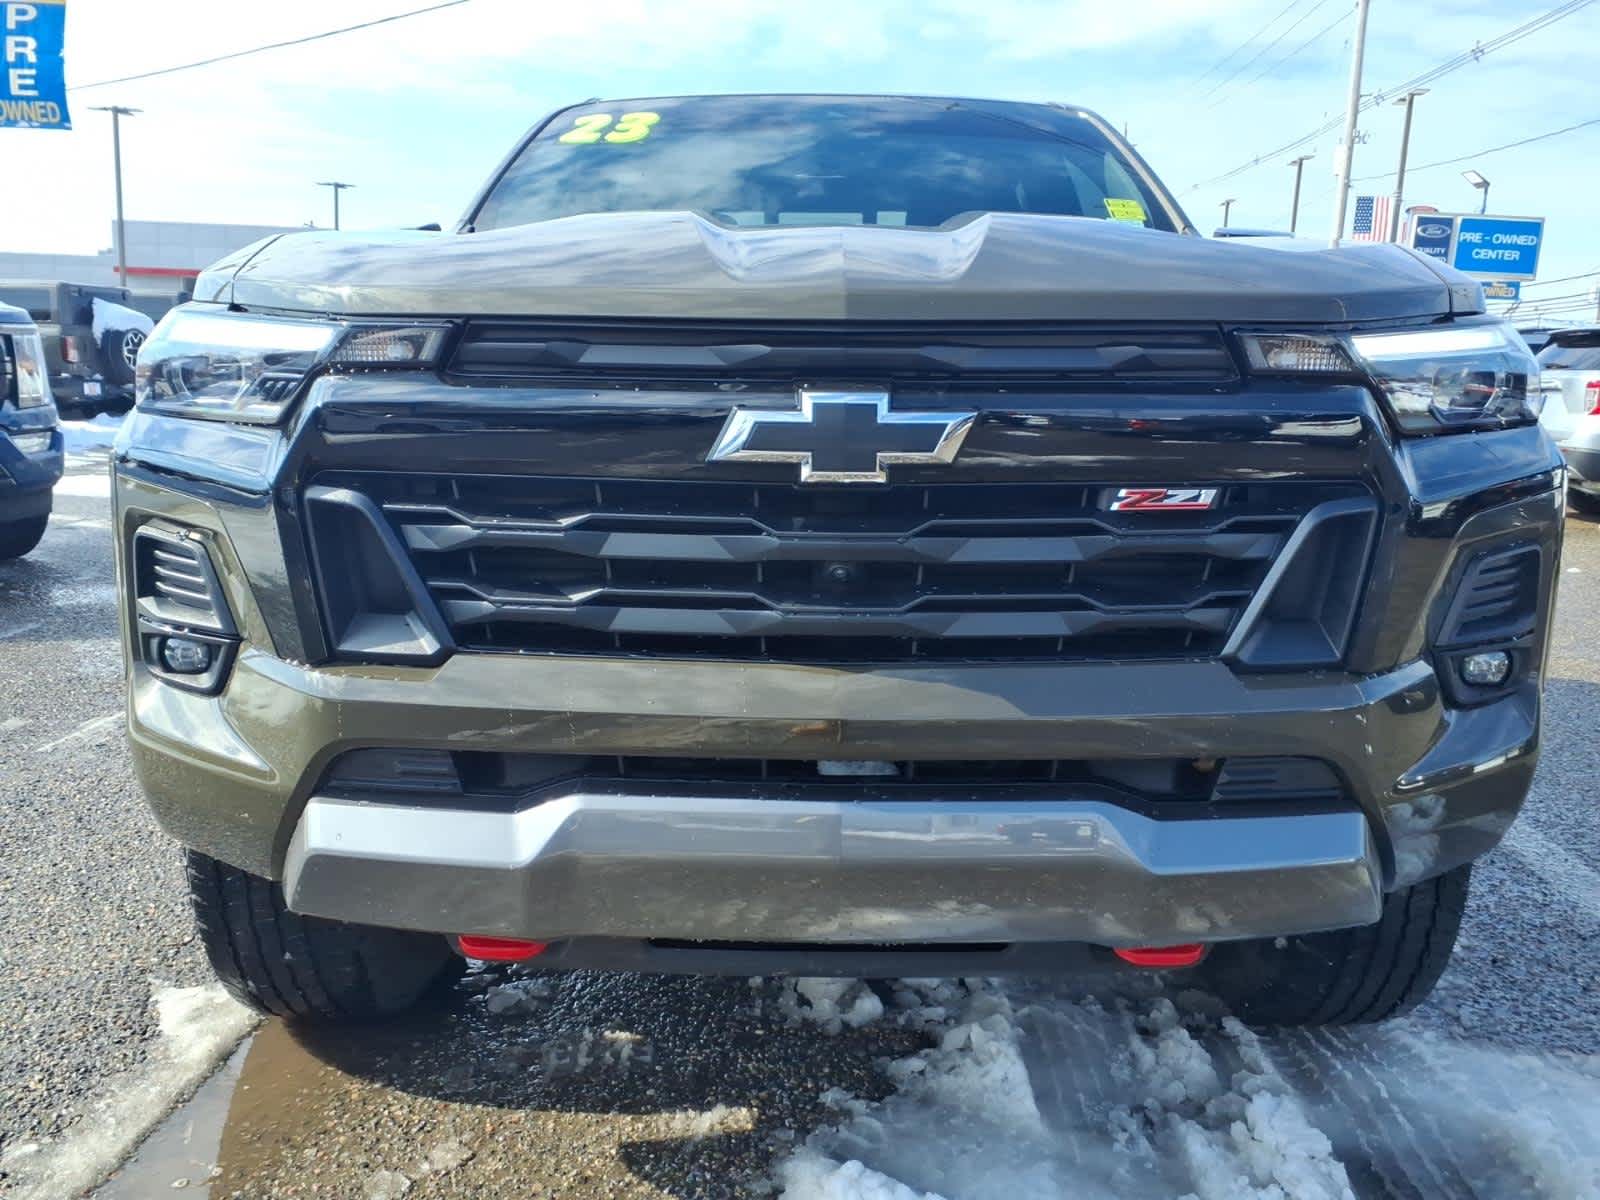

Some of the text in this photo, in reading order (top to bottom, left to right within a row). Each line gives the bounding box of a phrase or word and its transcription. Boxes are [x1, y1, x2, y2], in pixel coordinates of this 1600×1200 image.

[6, 3, 39, 96] PRE
[558, 111, 661, 144] 23
[1460, 231, 1483, 243] PRE
[1492, 233, 1537, 246] OWNED
[1471, 248, 1520, 260] CENTER
[1109, 488, 1217, 511] Z71
